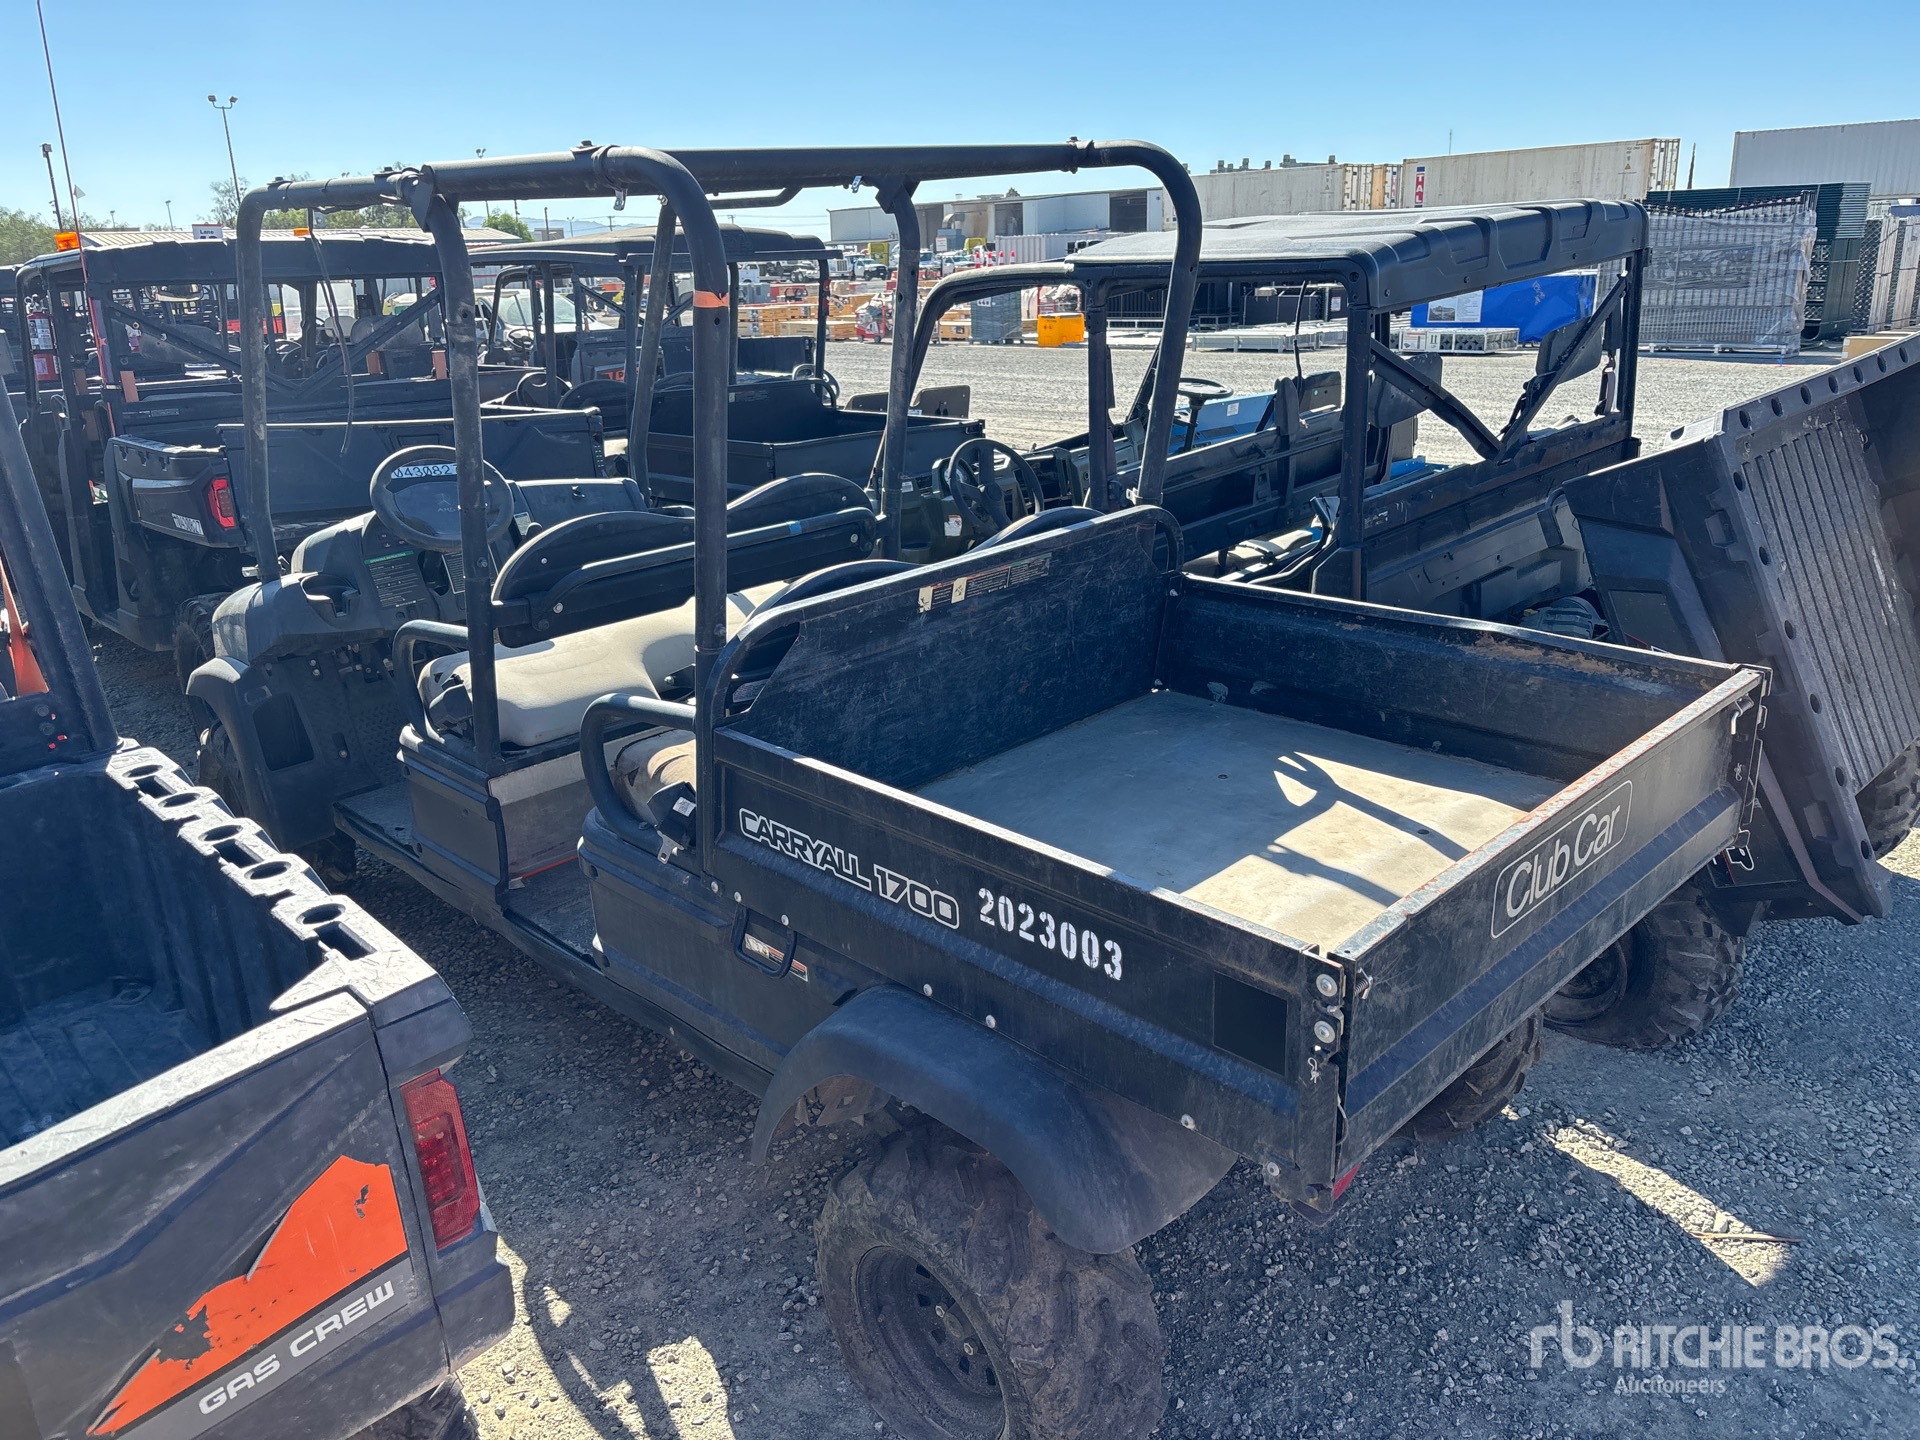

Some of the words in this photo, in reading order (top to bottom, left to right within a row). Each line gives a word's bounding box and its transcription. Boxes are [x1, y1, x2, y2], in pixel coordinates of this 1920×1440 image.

[1415, 174, 1424, 203] TAL
[393, 464, 458, 478] 043082
[739, 808, 872, 889] CARRYALL
[873, 865, 959, 929] 1700
[1507, 839, 1571, 918] Club
[1574, 805, 1620, 866] Car
[978, 888, 1122, 980] 2023003
[199, 1354, 281, 1415] GAS
[290, 1281, 395, 1358] CREW
